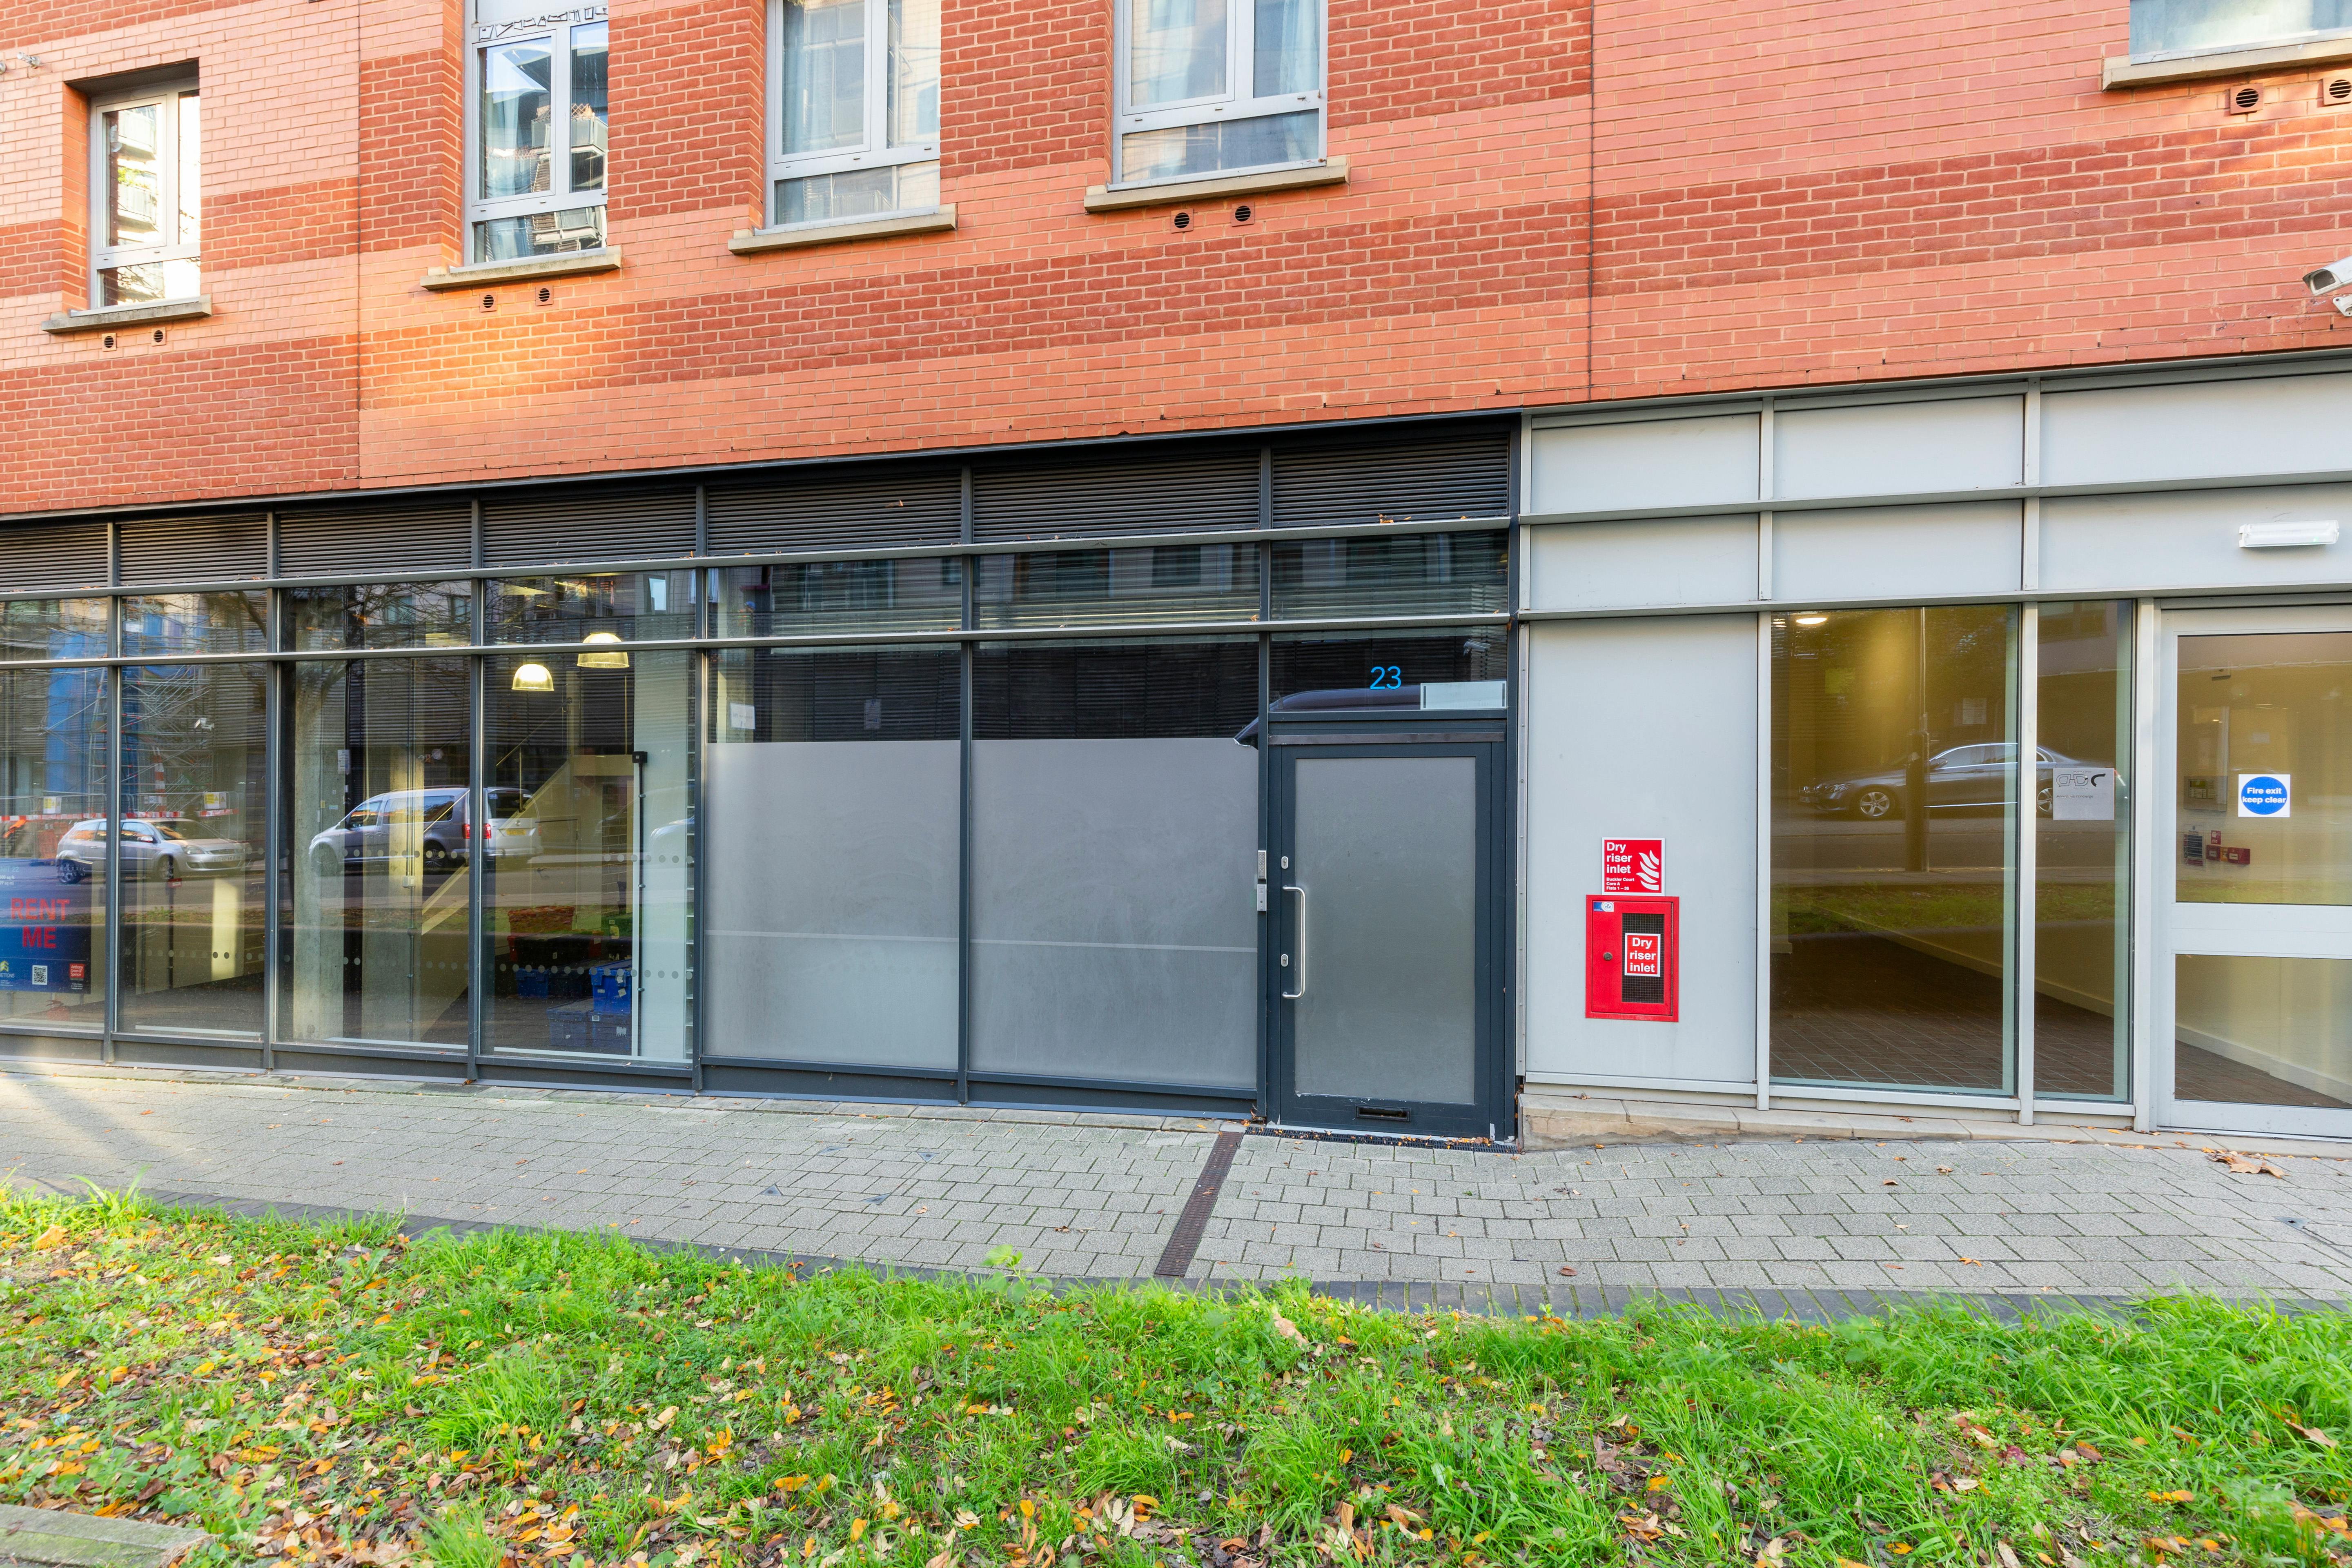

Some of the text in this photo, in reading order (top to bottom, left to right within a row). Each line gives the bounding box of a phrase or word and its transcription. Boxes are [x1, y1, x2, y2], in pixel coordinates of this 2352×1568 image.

[1370, 666, 1401, 690] 23
[1606, 842, 1626, 853] Dry
[1606, 853, 1633, 862] riser
[1606, 864, 1631, 873] inlet
[11, 898, 70, 921] RENT
[22, 926, 56, 948] ME
[1633, 937, 1653, 949] Dry
[1630, 950, 1656, 960] riser
[1630, 962, 1655, 973] inlet
